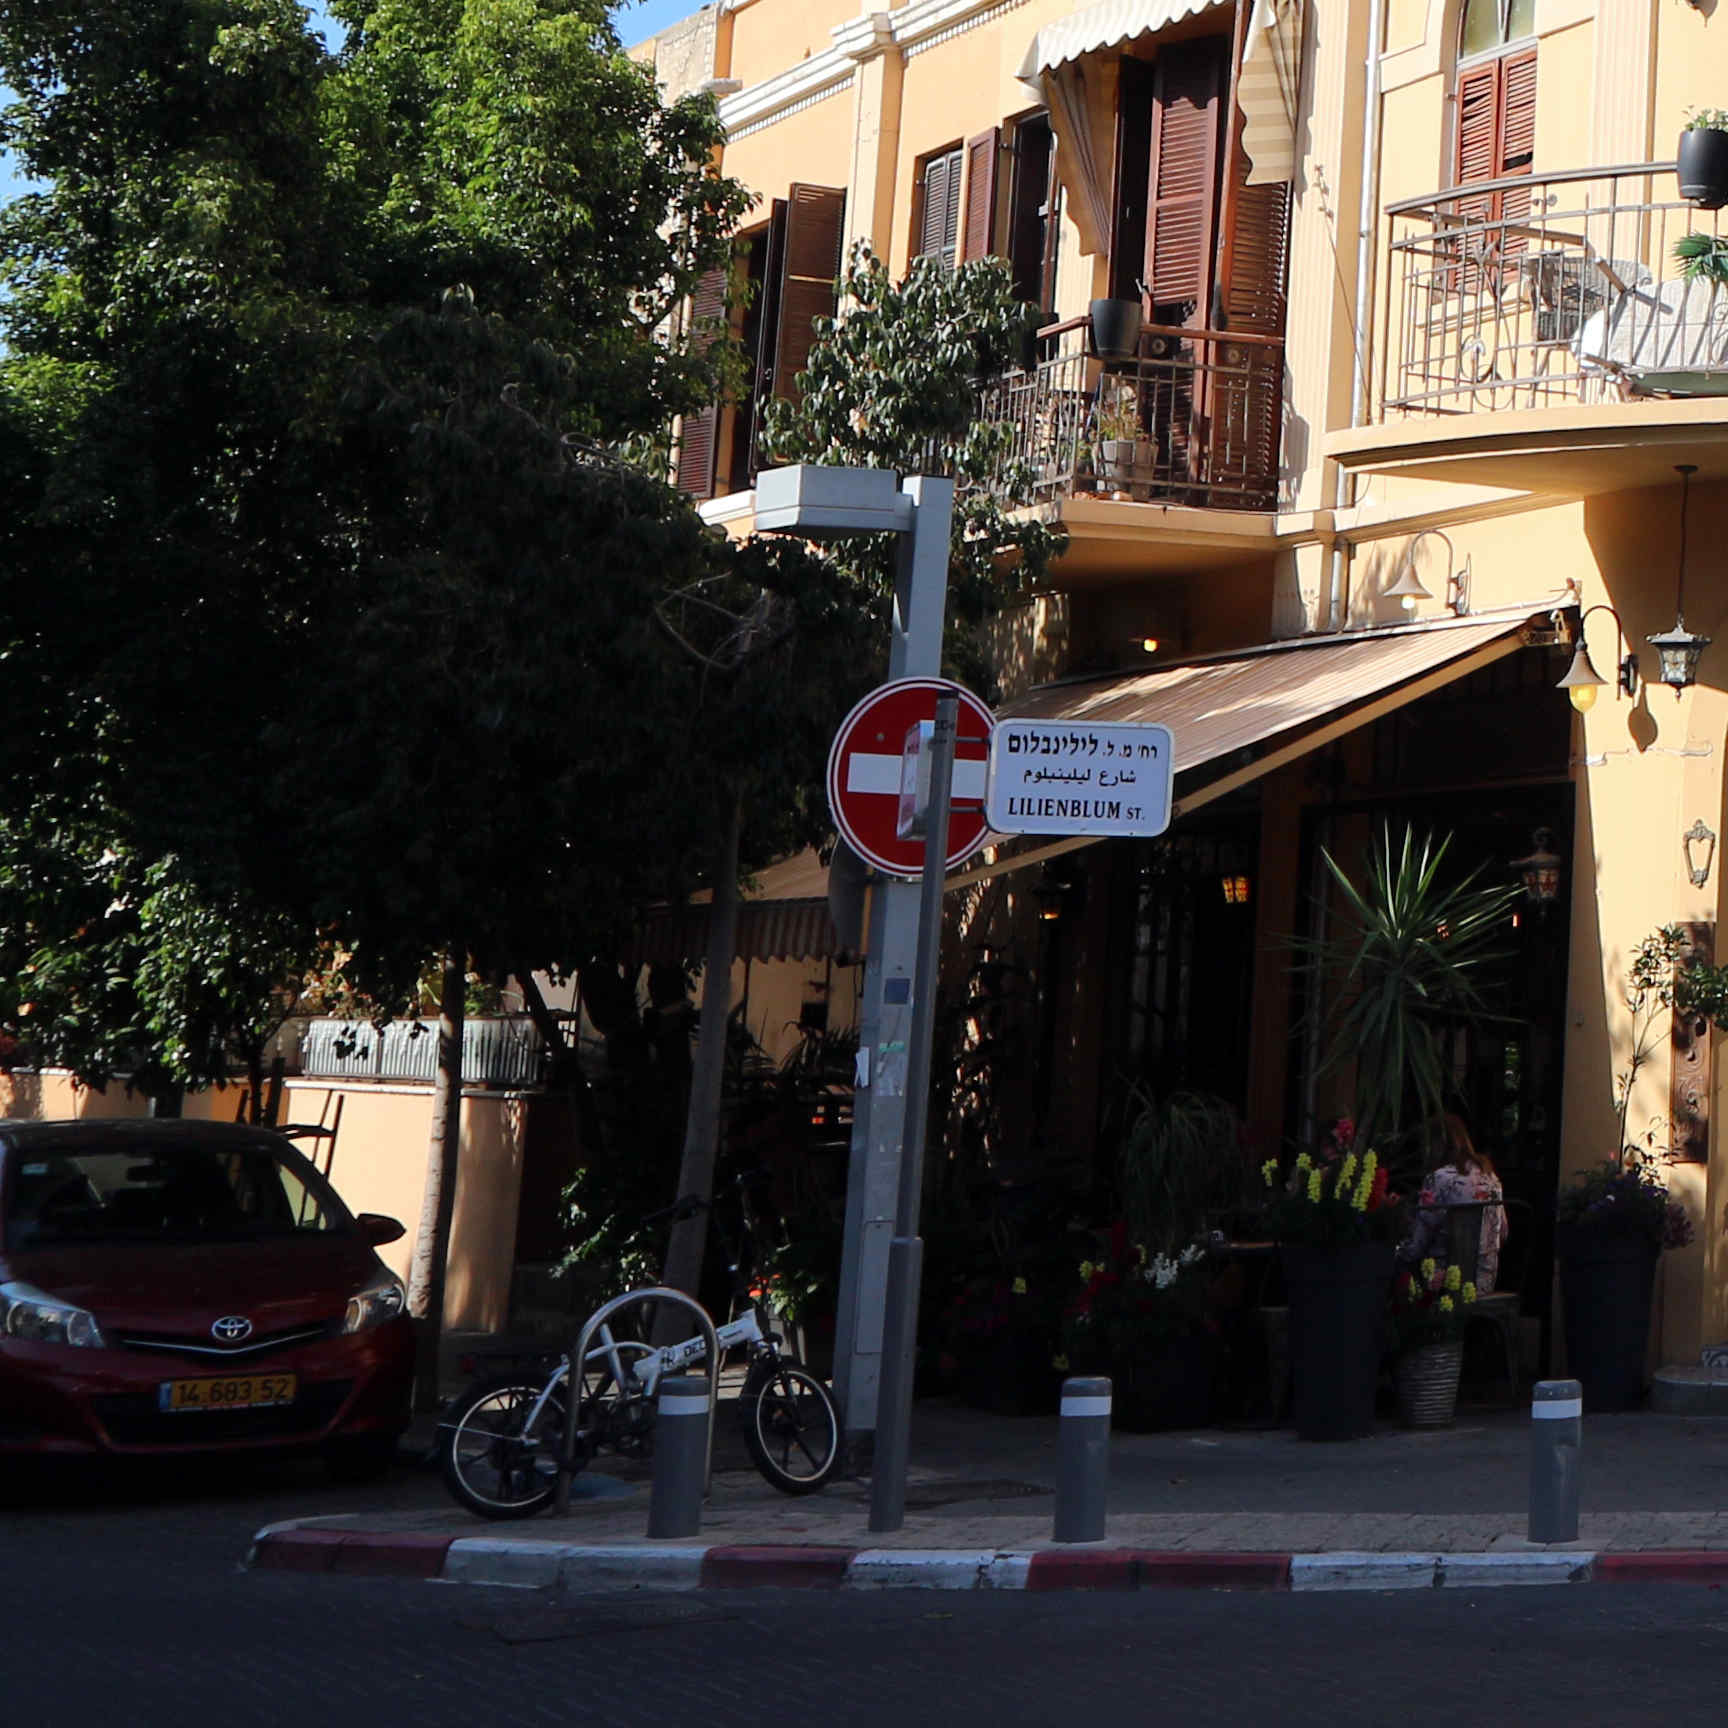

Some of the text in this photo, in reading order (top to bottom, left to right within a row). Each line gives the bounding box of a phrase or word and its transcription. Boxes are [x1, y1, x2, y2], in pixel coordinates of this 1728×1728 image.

[1007, 730, 1099, 756] לילינבלום
[1023, 765, 1137, 786] شارع ليلينبلوم
[1007, 796, 1146, 821] LILIENBLUM ST.
